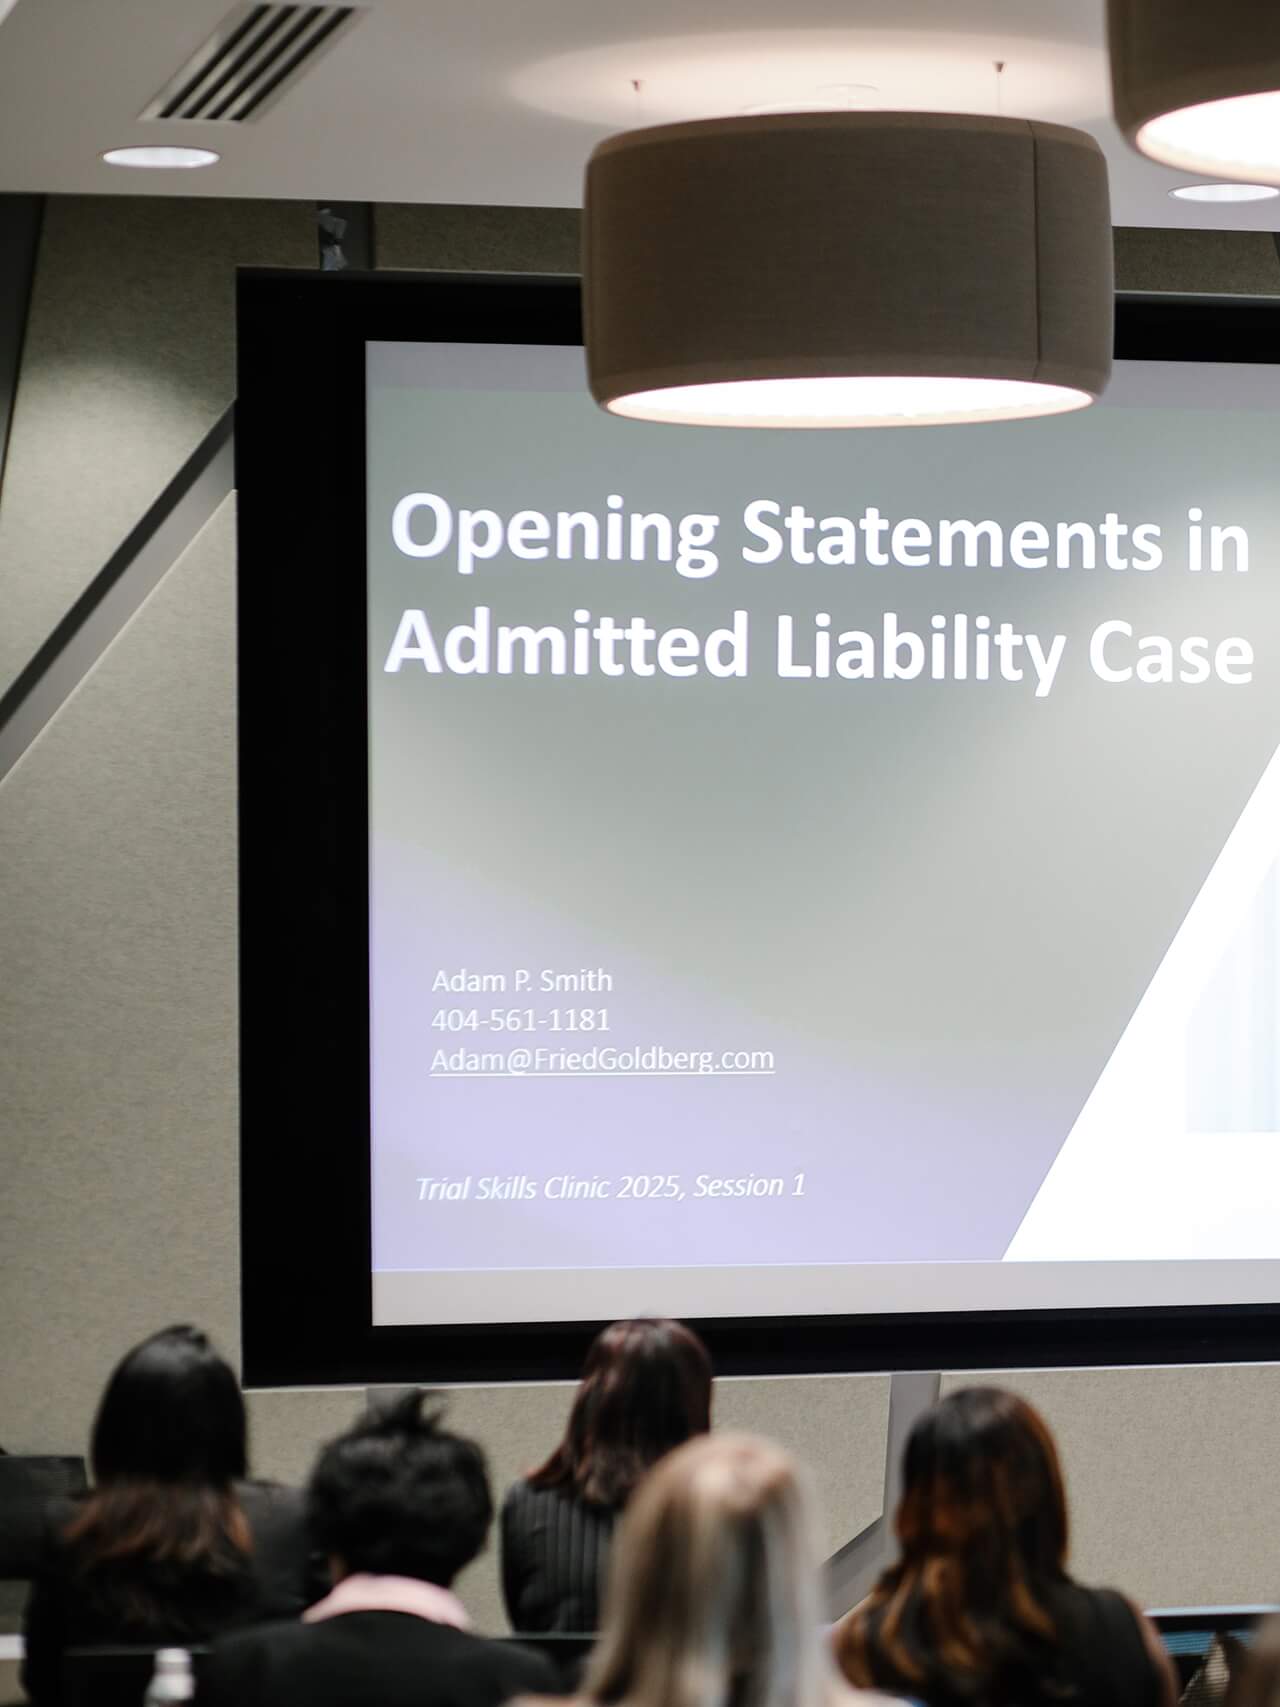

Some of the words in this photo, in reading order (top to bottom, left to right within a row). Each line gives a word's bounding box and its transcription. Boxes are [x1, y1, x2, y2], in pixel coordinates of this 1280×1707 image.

[391, 492, 720, 579] Opening
[742, 499, 1163, 571] Statements
[1188, 507, 1249, 572] in
[383, 606, 748, 678] Admitted
[777, 612, 1067, 698] Liability
[1089, 619, 1254, 685] Case
[431, 968, 506, 993] Adam
[514, 969, 533, 993] P.
[539, 968, 614, 993] Smith
[430, 1008, 610, 1032] 404-561-1181
[429, 1045, 776, 1077] Adam@FriedGoldberg.com
[416, 1175, 472, 1201] Trial
[475, 1175, 539, 1200] Skills
[543, 1175, 611, 1199] Clinic
[615, 1175, 687, 1202] 2025,
[692, 1174, 785, 1198] Session
[791, 1173, 806, 1197] 1
